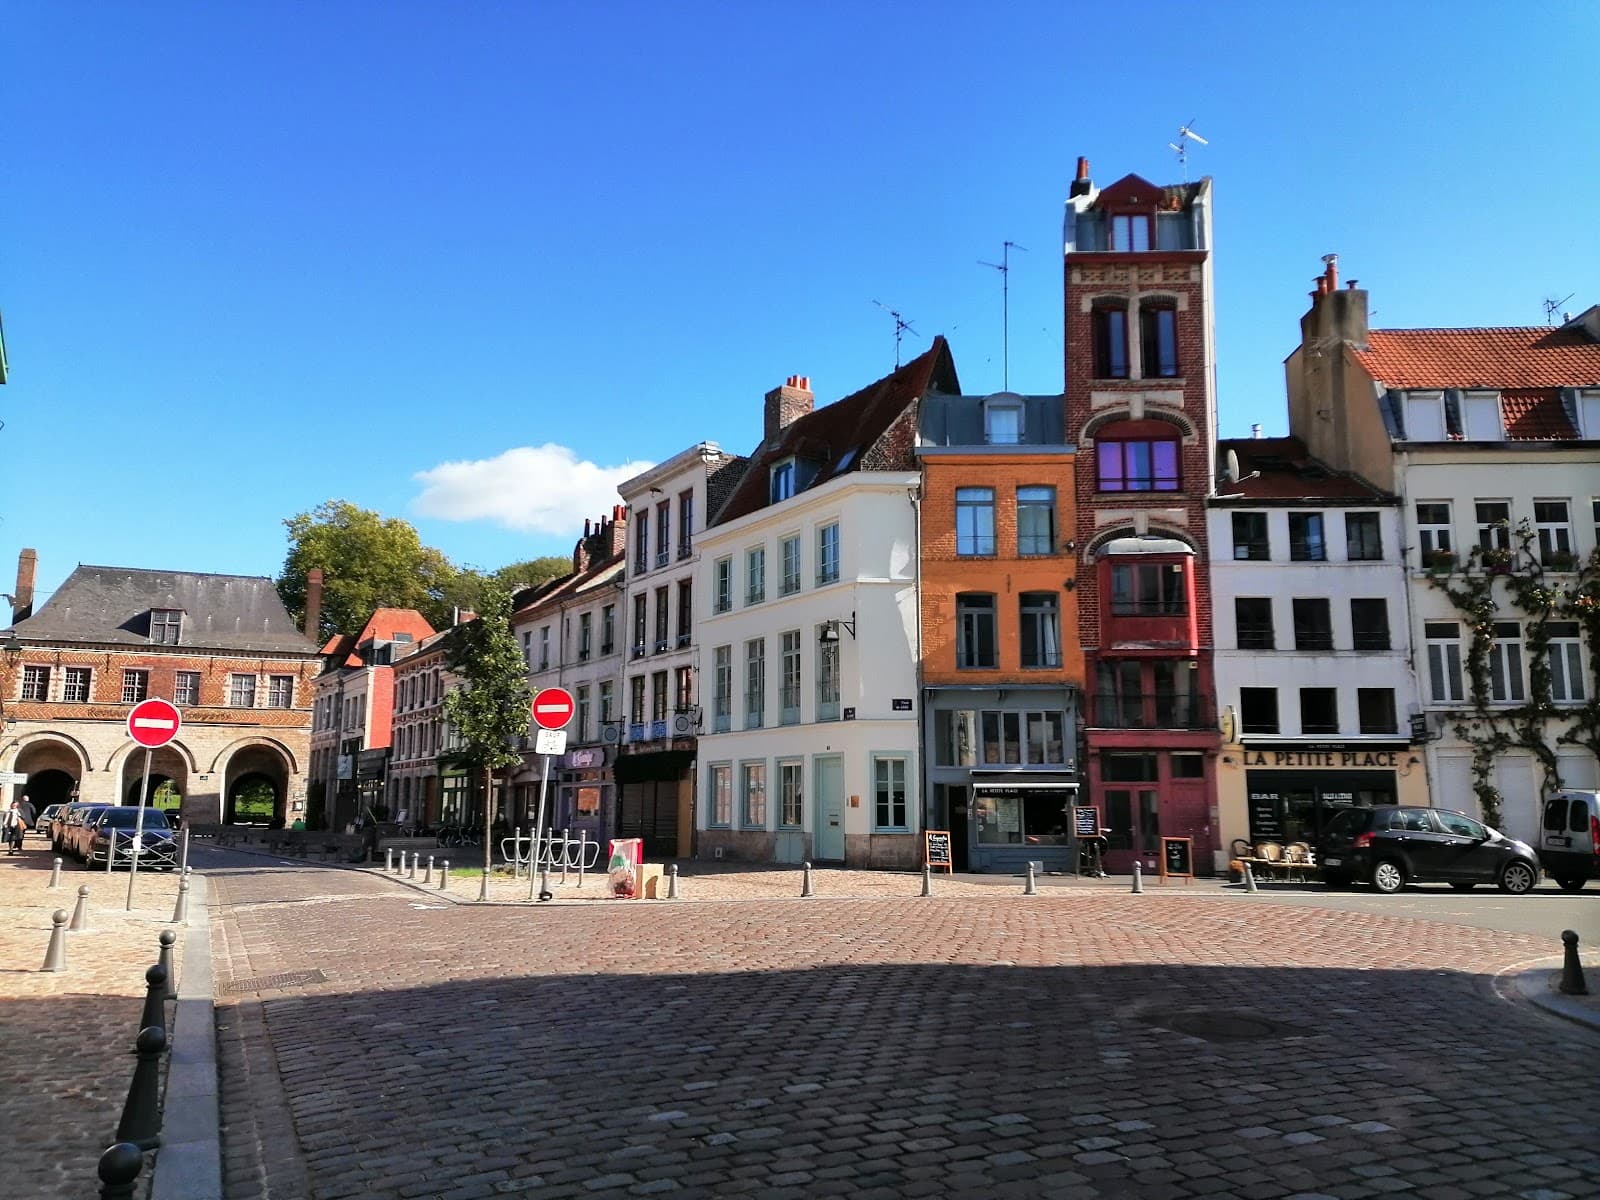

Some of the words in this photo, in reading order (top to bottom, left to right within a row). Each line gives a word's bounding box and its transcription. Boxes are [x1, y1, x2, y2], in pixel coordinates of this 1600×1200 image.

[1244, 752, 1267, 767] LA
[1276, 752, 1335, 767] PETITE
[1343, 752, 1399, 767] PLACE
